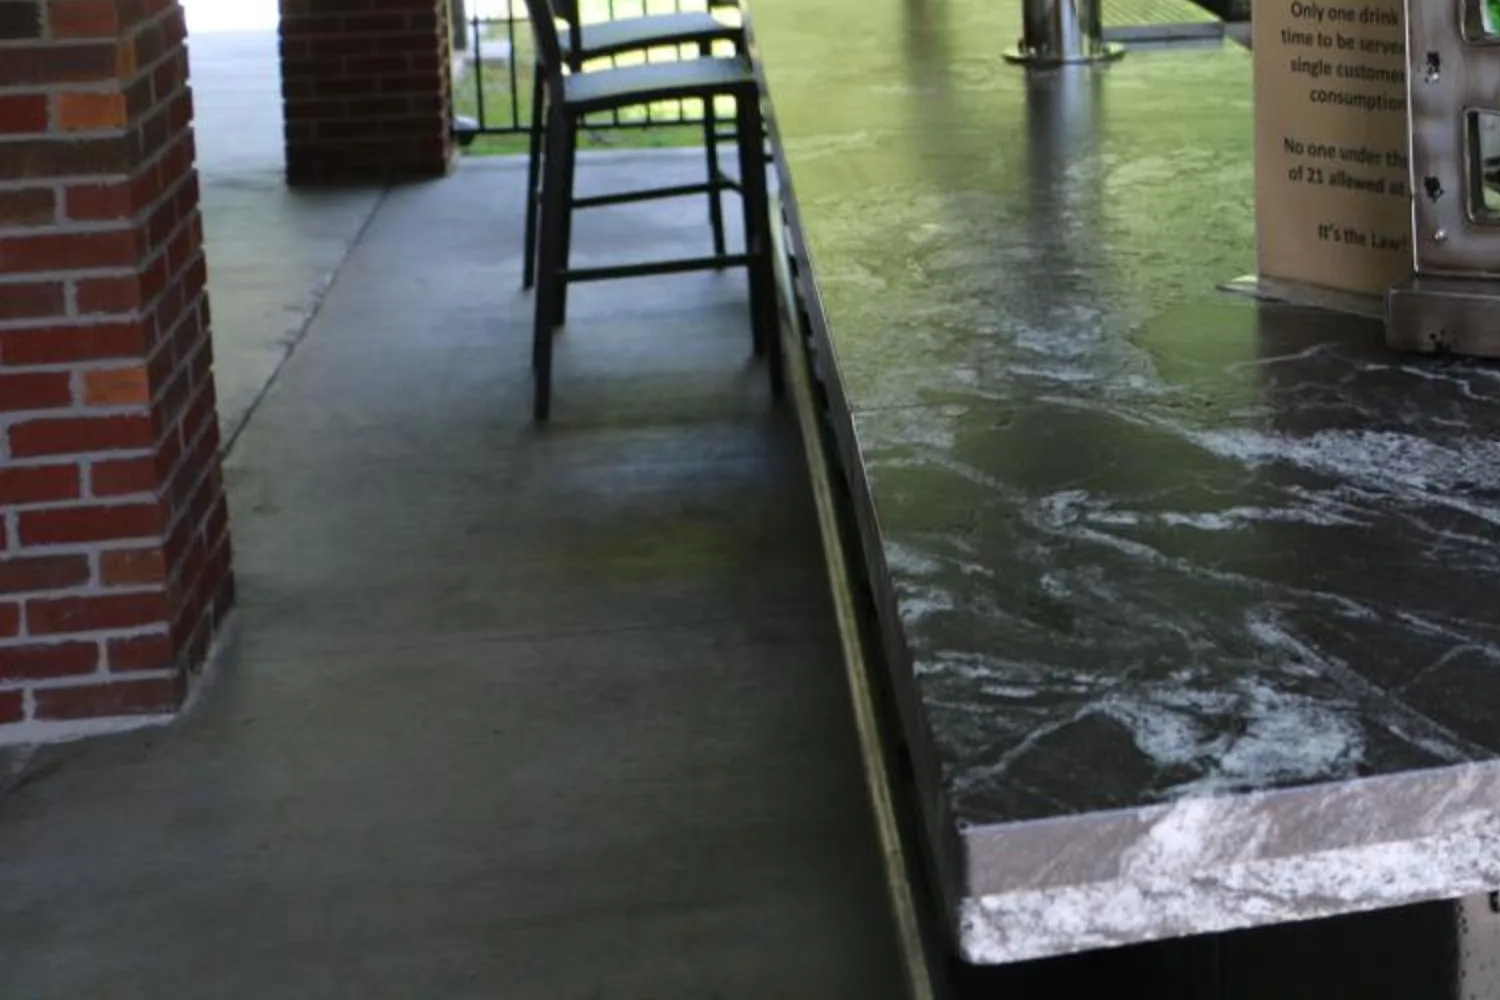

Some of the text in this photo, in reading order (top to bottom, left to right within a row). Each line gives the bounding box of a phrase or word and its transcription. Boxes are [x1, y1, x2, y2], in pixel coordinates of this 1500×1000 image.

[1290, 0, 1399, 26] Only one drink
[1281, 28, 1314, 47] time
[1317, 31, 1333, 49] to
[1336, 32, 1355, 50] be
[1290, 56, 1333, 78] single
[1283, 137, 1304, 155] No
[1306, 142, 1336, 159] one
[1339, 145, 1382, 166] under
[1288, 164, 1303, 182] of
[1306, 167, 1324, 185] 21
[1328, 169, 1385, 194] allowed
[1318, 223, 1341, 242] It's
[1343, 228, 1367, 247] the
